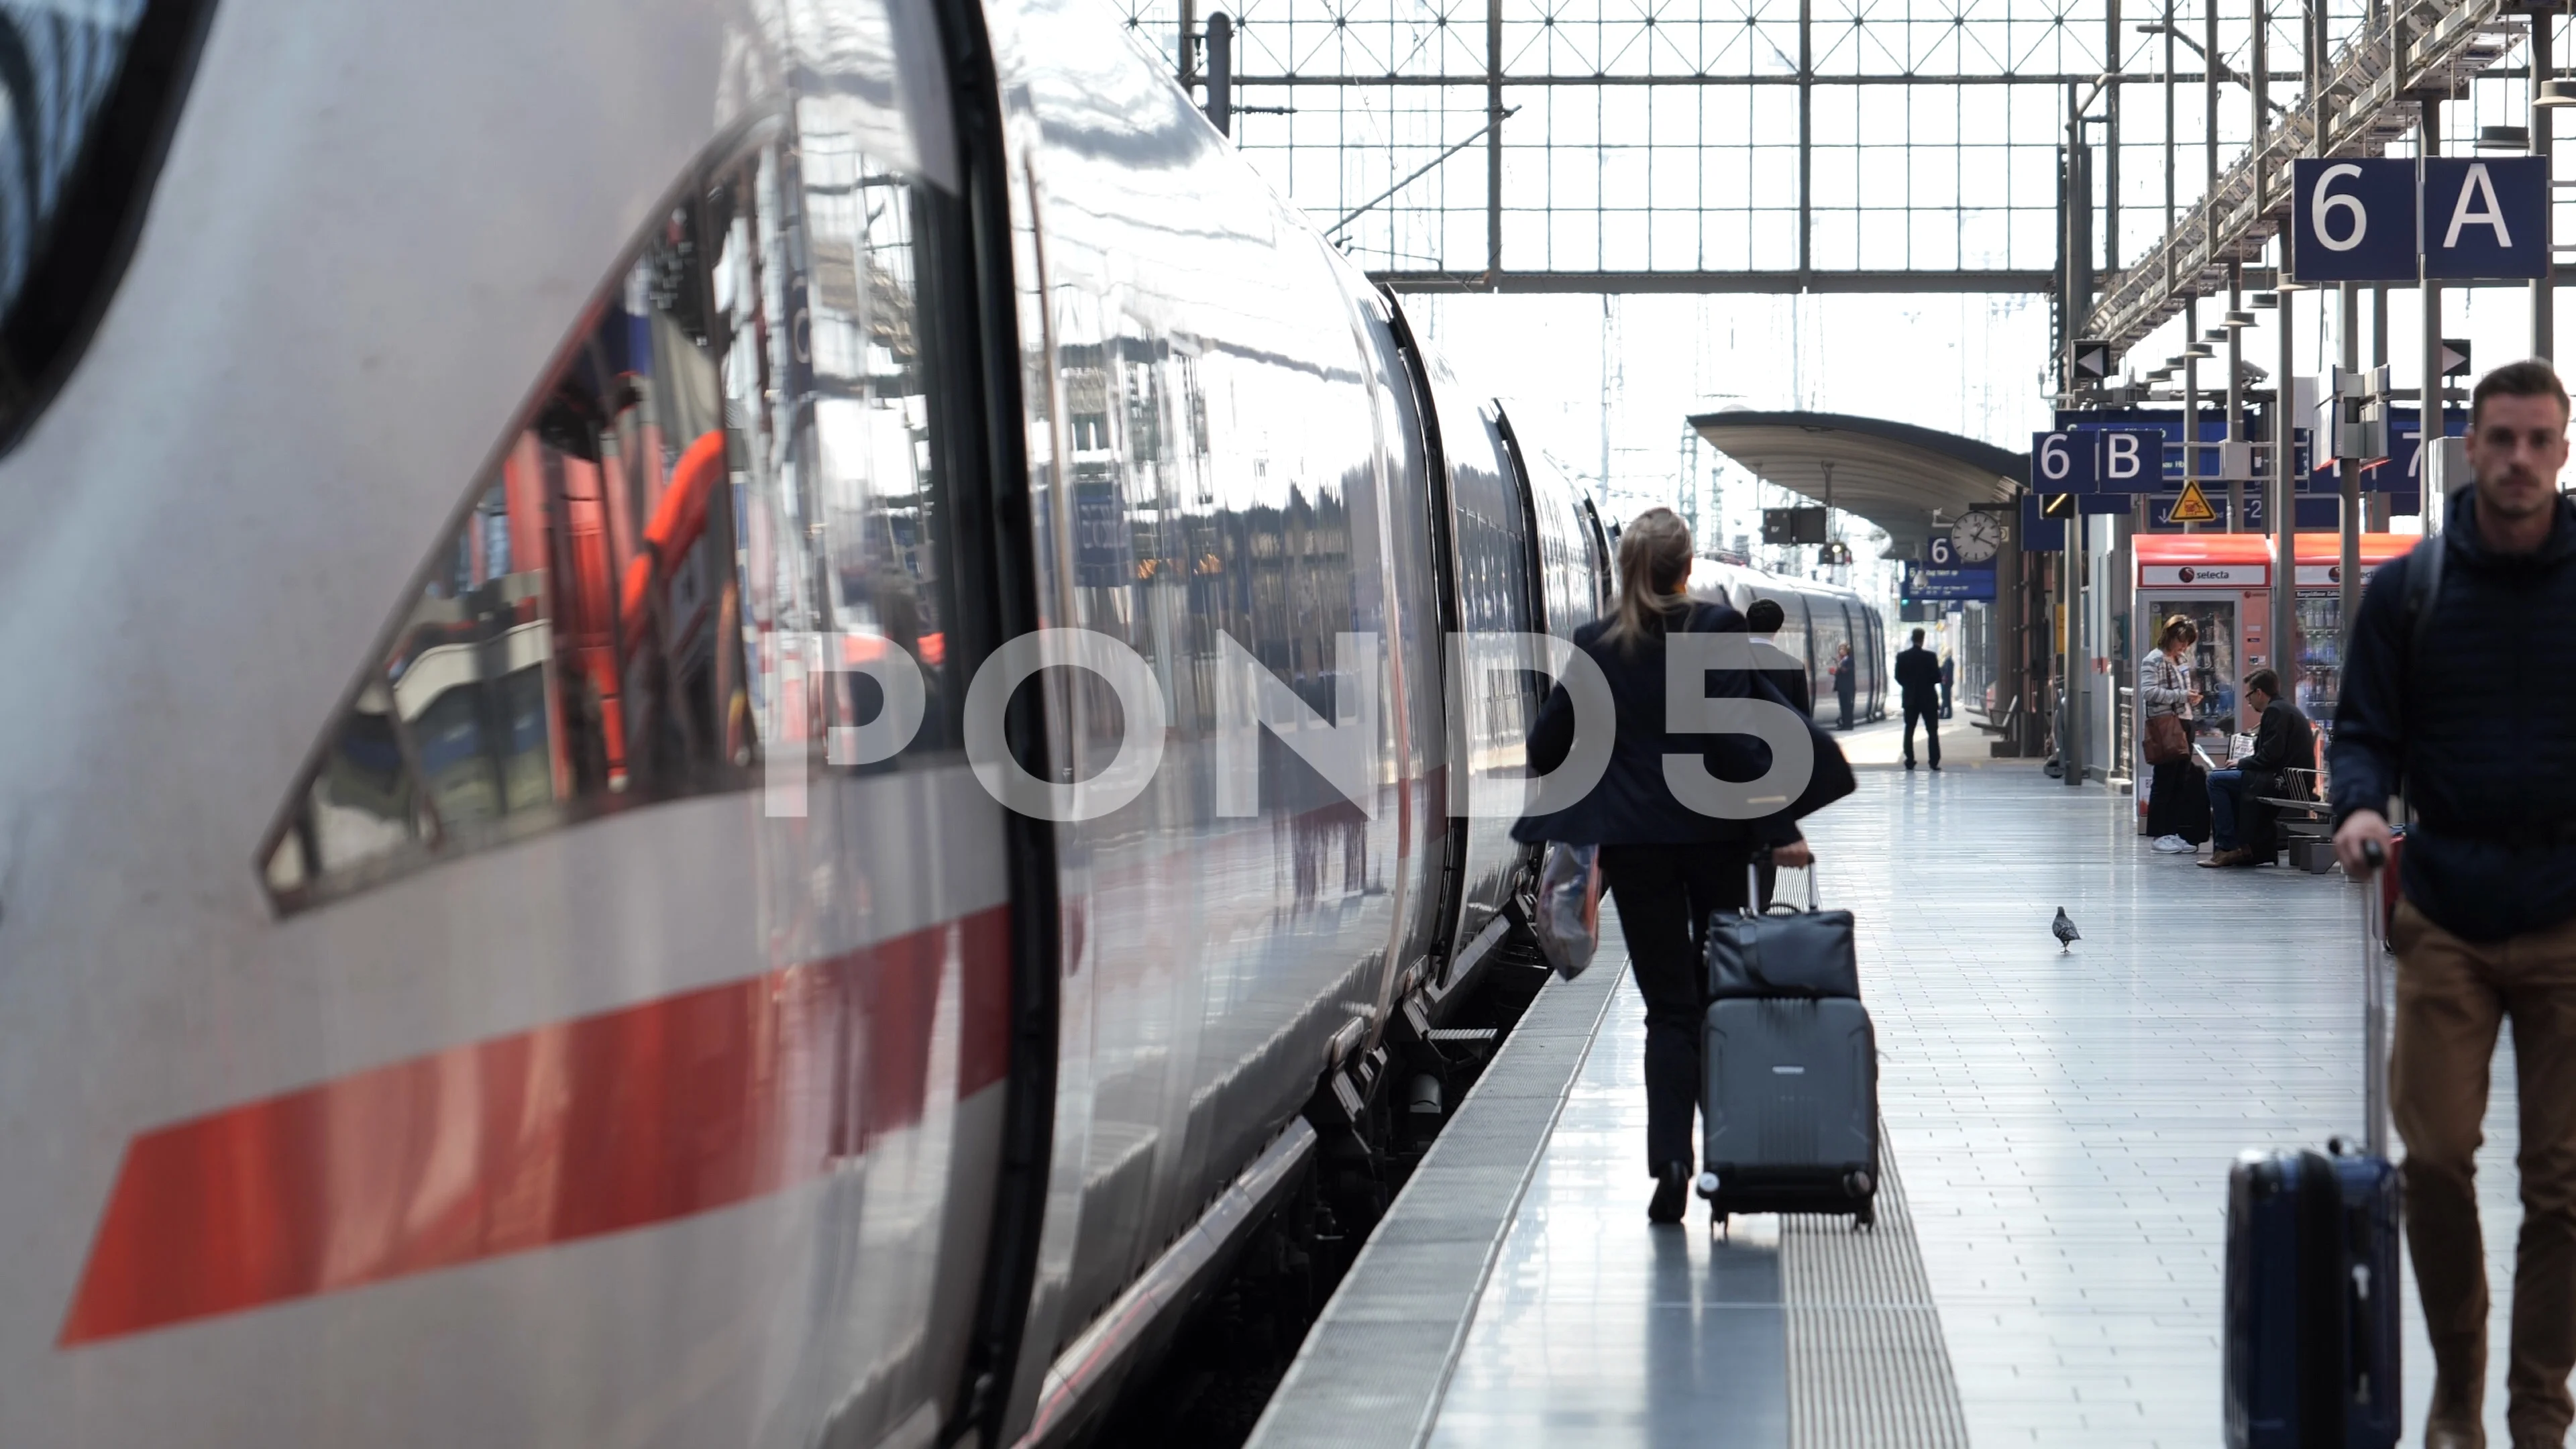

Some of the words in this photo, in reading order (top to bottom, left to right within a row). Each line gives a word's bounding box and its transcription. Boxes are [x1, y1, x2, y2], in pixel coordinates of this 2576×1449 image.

[2312, 163, 2367, 252] 6
[2442, 163, 2513, 248] A
[2041, 433, 2070, 480] 6
[2108, 433, 2141, 478] B
[1931, 537, 1949, 564] 6
[2197, 571, 2229, 579] selecta
